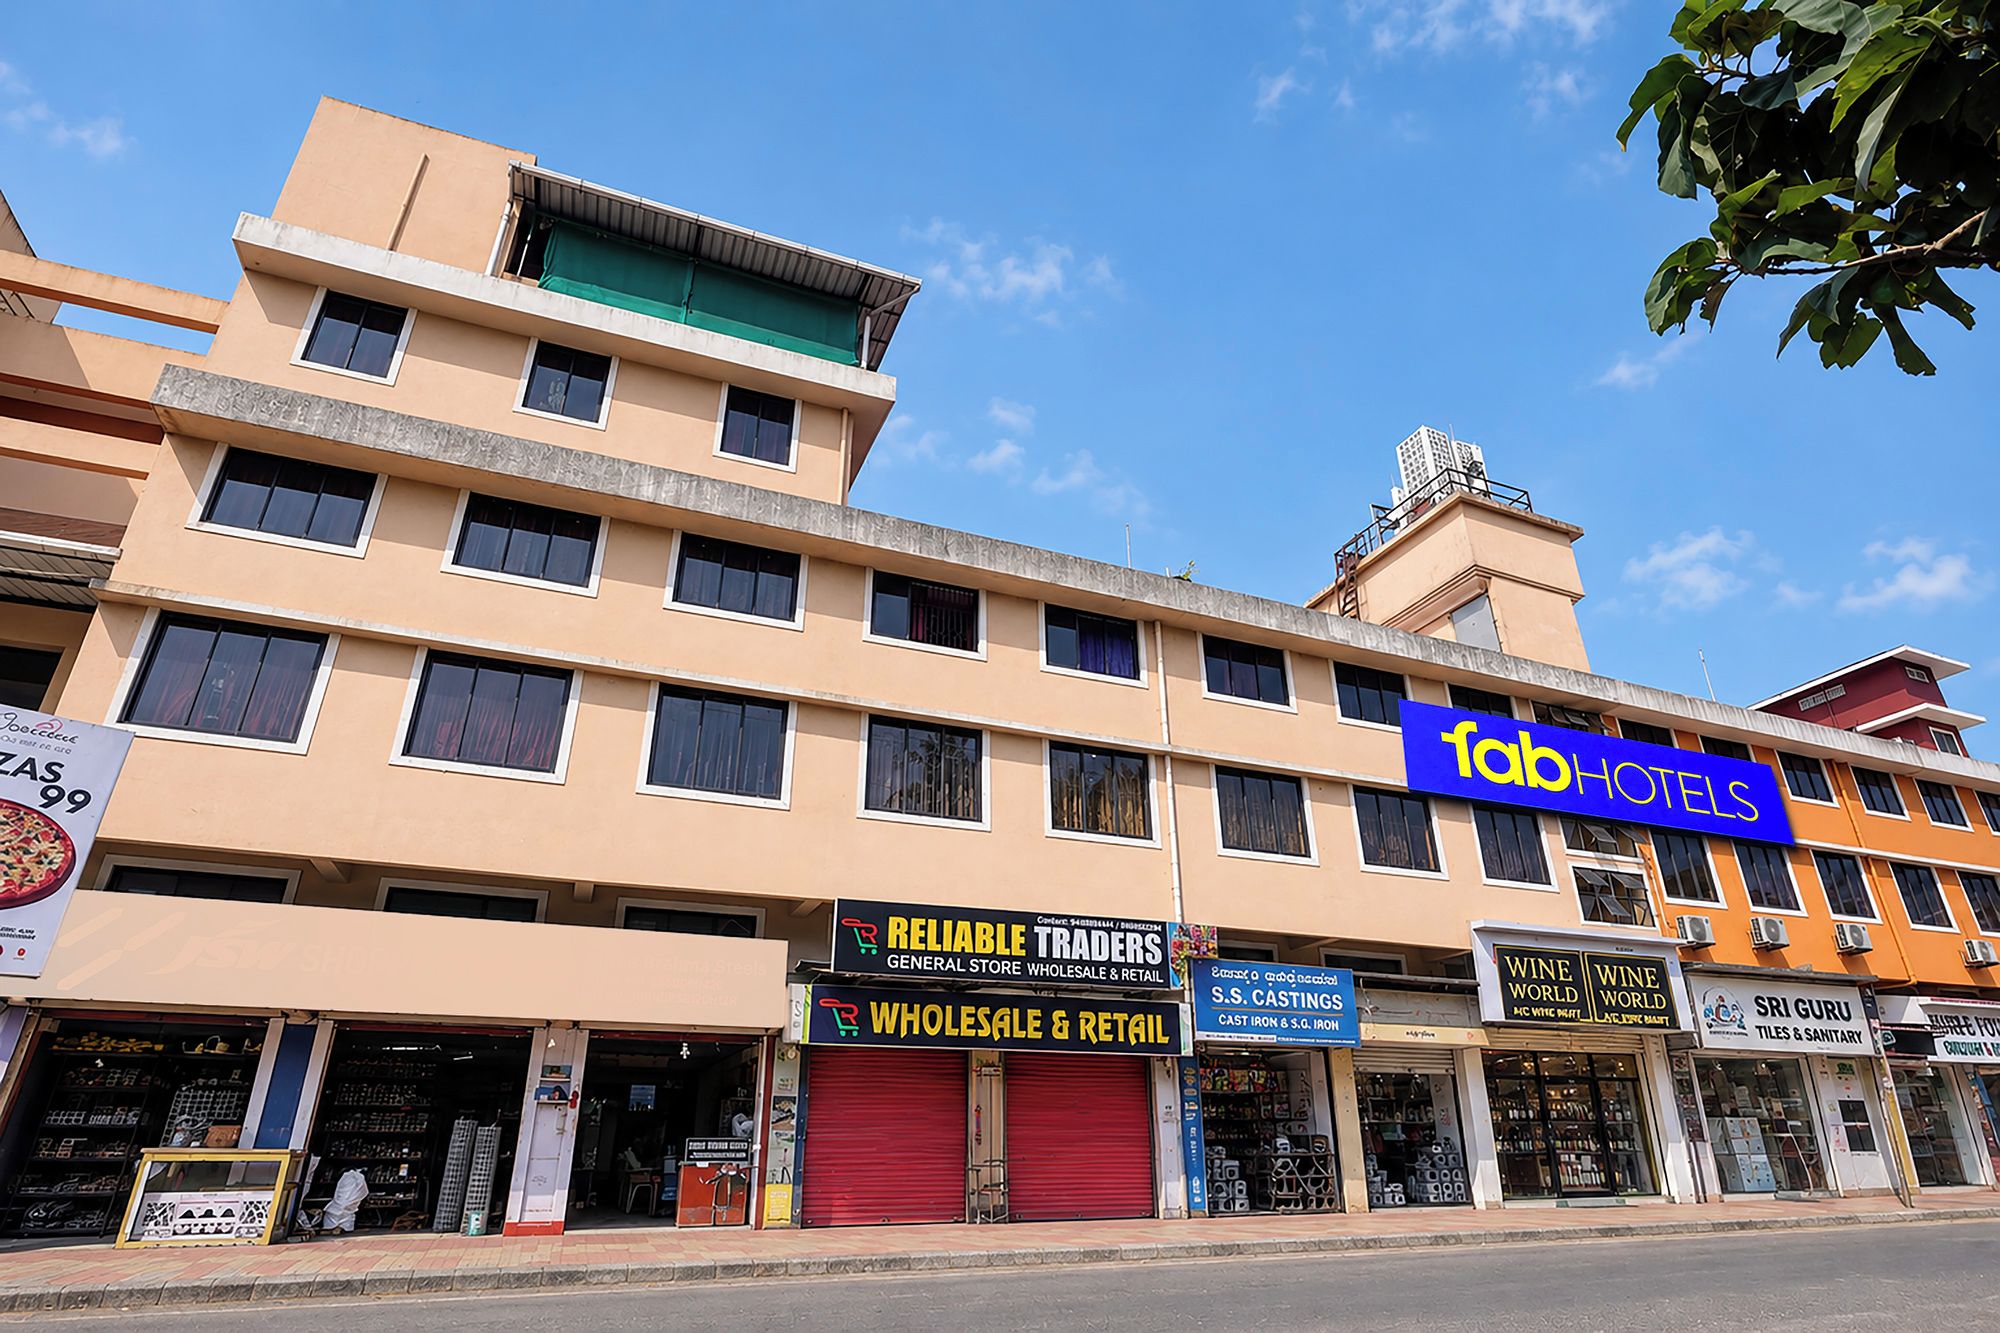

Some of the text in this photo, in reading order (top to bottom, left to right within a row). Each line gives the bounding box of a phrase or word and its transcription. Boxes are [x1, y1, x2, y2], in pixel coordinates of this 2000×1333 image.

[39, 785, 92, 814] 99
[887, 916, 1162, 966] RELIABLE TRADERS
[887, 954, 1164, 983] GENERAL STORE WHOLESALE & RETAIL
[1504, 955, 1574, 982] WINE
[1594, 963, 1660, 989] WINE
[1211, 986, 1344, 1011] S.S. CASTINGS
[1508, 982, 1579, 1003] WORLD
[1600, 990, 1667, 1010] WORLD
[1754, 995, 1852, 1022] SRI GURU
[870, 1001, 1170, 1046] WHOLESALE & RETAIL
[1218, 1014, 1249, 1026] CAST
[1251, 1016, 1278, 1028] IRON
[1314, 1019, 1340, 1031] IRON
[1755, 1025, 1791, 1041] TILES
[1793, 1028, 1802, 1041] &
[1805, 1028, 1864, 1045] SANITARY
